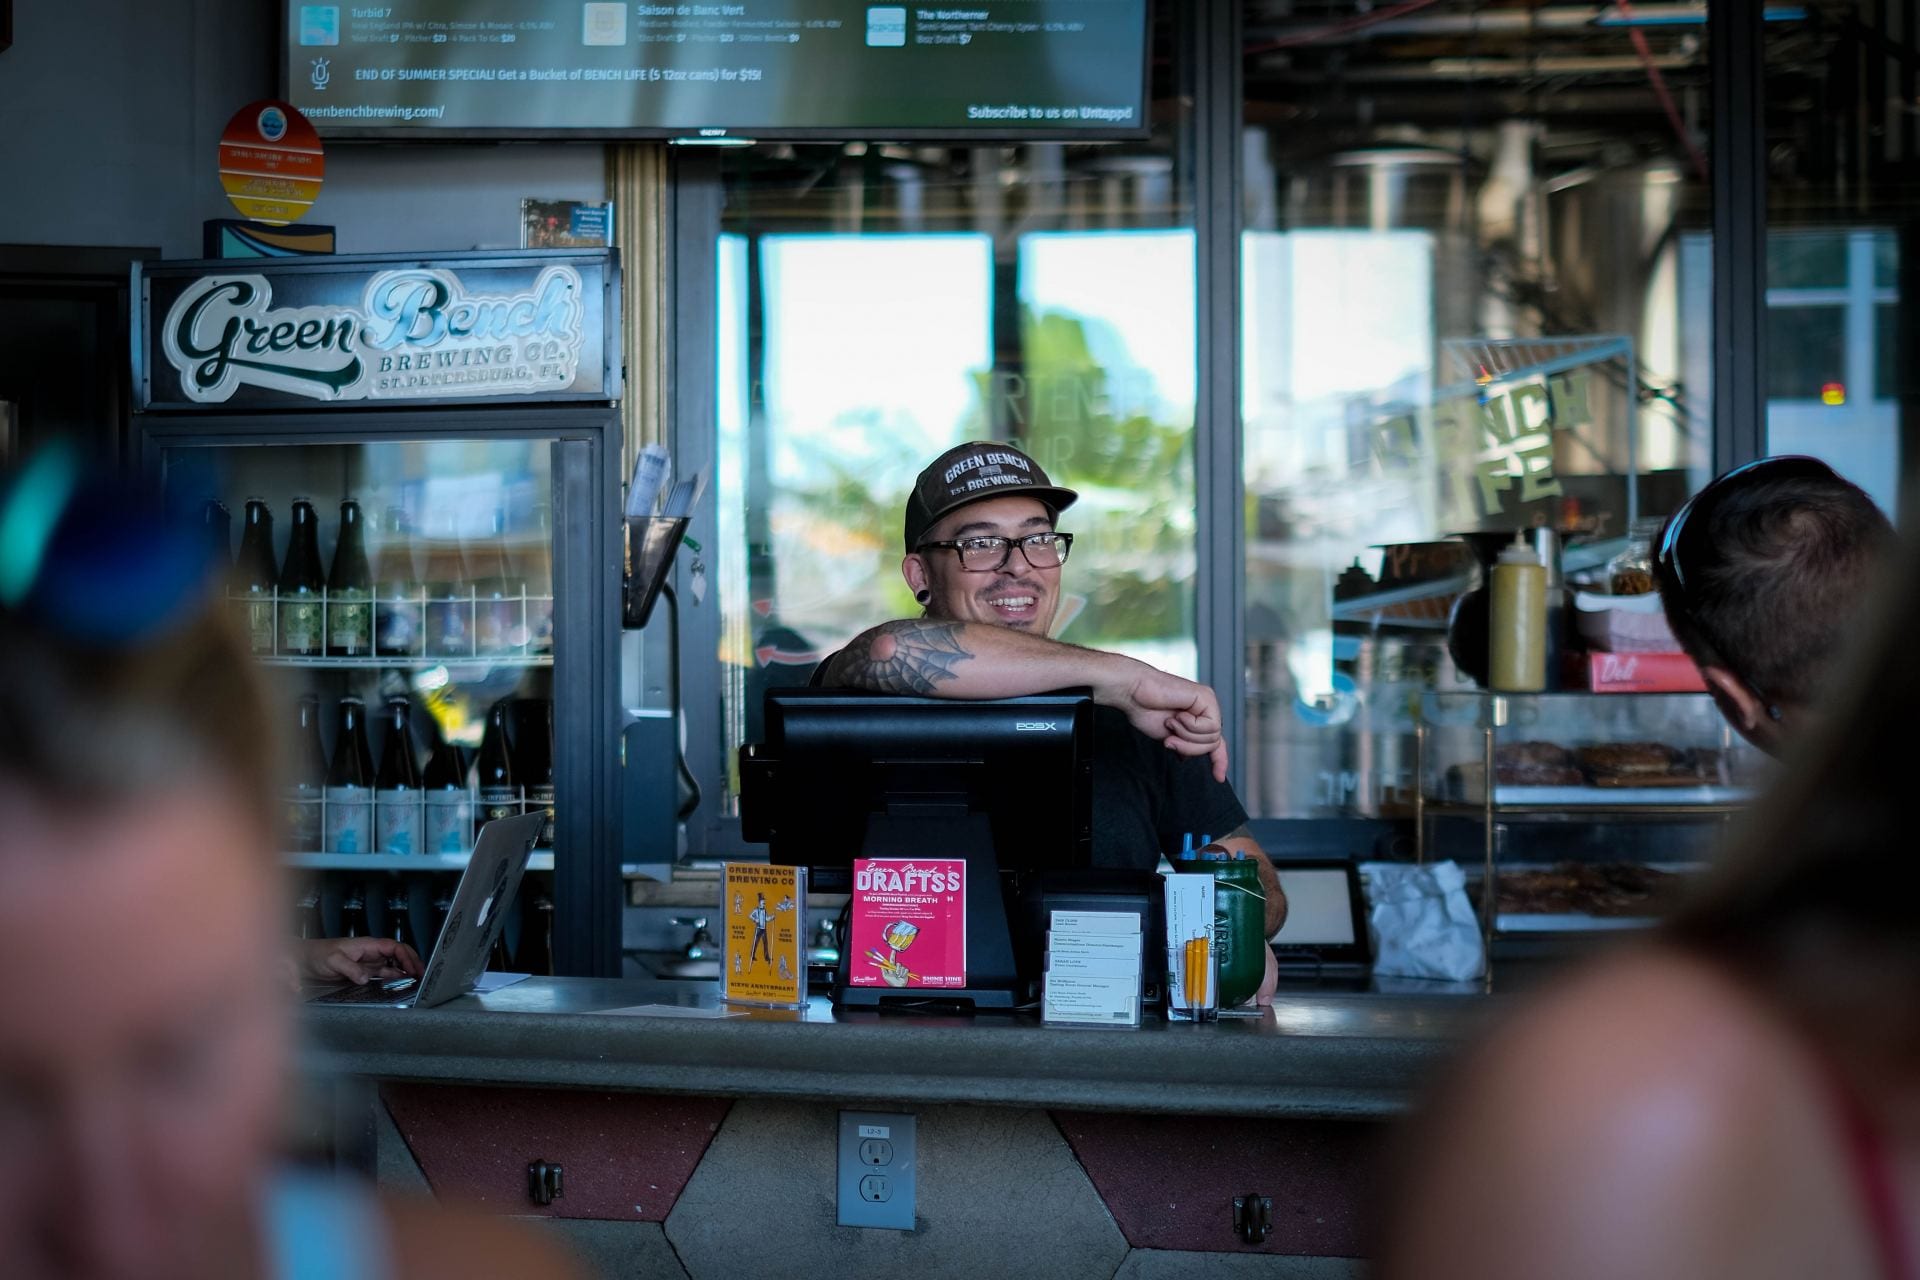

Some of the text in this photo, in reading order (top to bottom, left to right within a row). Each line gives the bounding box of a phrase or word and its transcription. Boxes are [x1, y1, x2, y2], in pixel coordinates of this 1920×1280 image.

[638, 5, 674, 16] Saison
[676, 5, 691, 16] de
[722, 5, 745, 16] Vert
[355, 69, 378, 80] END
[381, 69, 397, 80] OF
[399, 69, 446, 80] SUMMER
[448, 69, 496, 80] SPECIAL!
[498, 69, 517, 81] Get
[519, 72, 527, 81] a
[529, 68, 568, 81] Bucket
[570, 69, 583, 81] of
[584, 69, 622, 81] BENCH
[624, 69, 647, 81] LIFE
[721, 69, 737, 81] for
[967, 106, 1028, 119] Subscribe
[1029, 107, 1044, 119] to
[1045, 108, 1061, 119] us
[1062, 108, 1079, 119] on
[176, 272, 571, 389] Green Bench
[379, 344, 513, 373] BREWING
[945, 453, 1030, 484] GREEN BENCH
[967, 475, 1021, 492] BREWING
[729, 866, 794, 876] GREEN BENCH
[729, 876, 778, 884] BREWING
[751, 983, 794, 992] ANNIVERSARY
